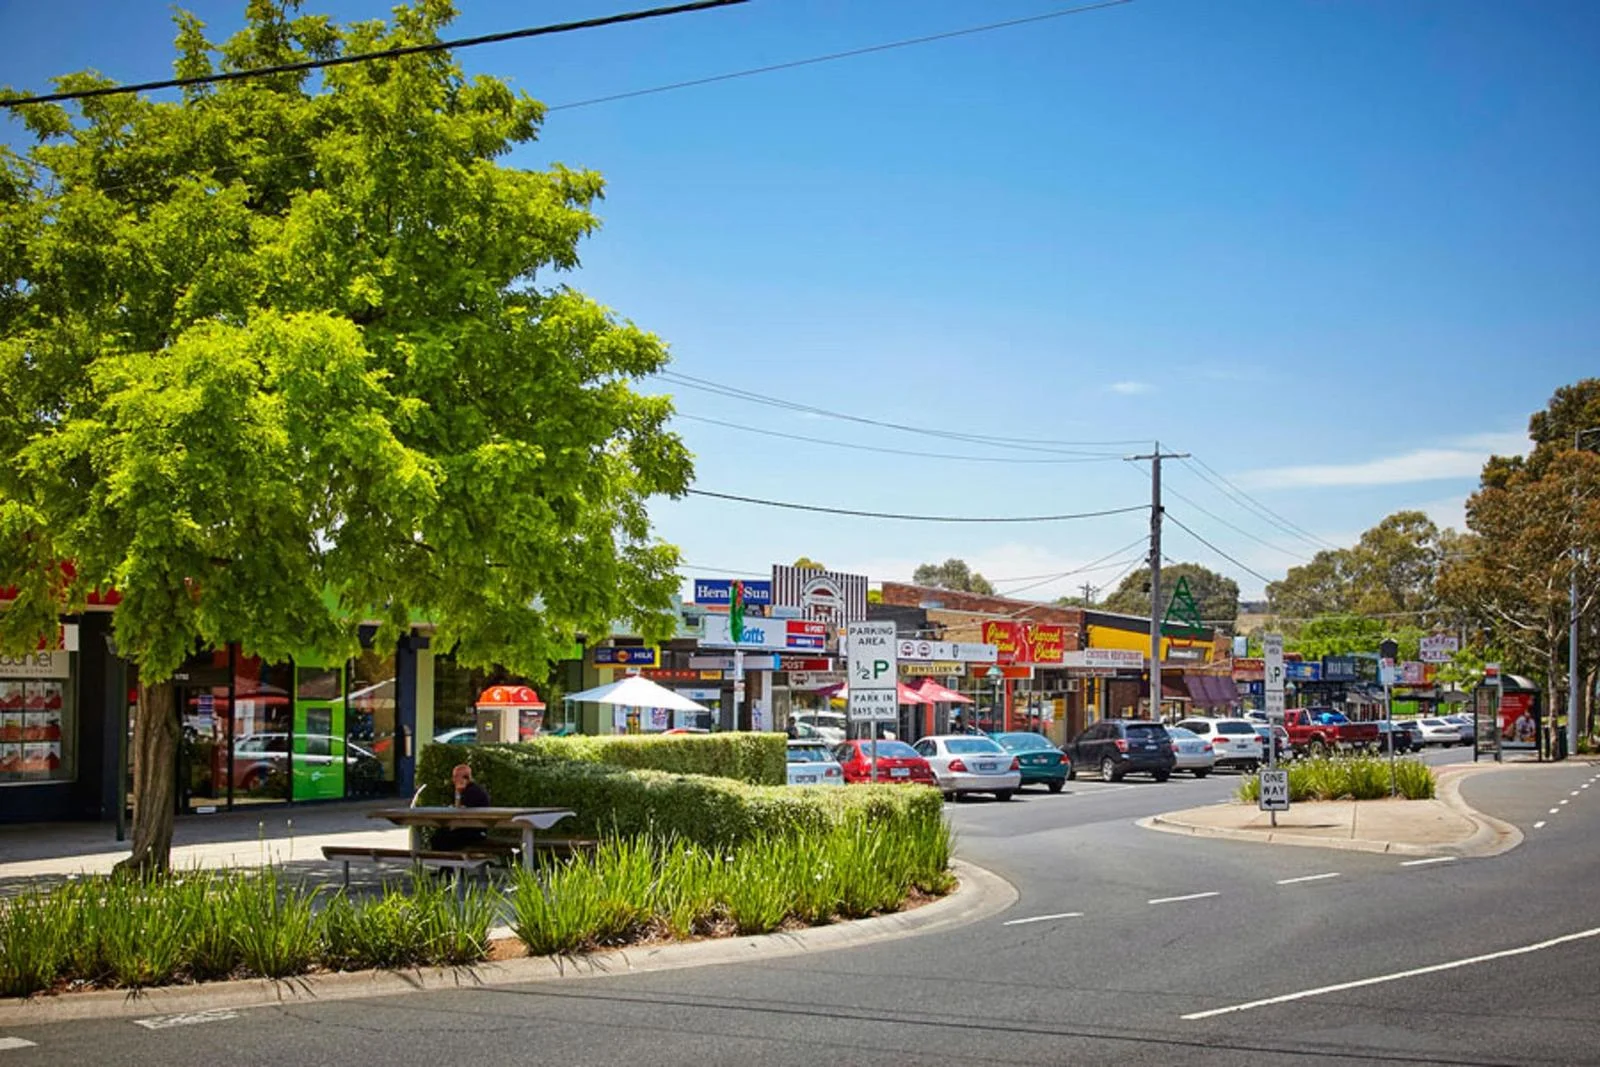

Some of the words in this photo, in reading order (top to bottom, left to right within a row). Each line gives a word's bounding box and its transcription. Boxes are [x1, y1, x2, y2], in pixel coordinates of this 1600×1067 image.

[697, 584, 734, 599] Heral
[743, 587, 769, 599] Sun
[741, 626, 766, 644] atts
[849, 627, 893, 635] PARKING
[858, 638, 886, 646] AREA
[633, 650, 653, 660] MILK
[854, 694, 878, 702] PARK
[883, 694, 893, 702] IN
[875, 706, 894, 715] ONLY
[1263, 773, 1285, 783] ONE
[1263, 785, 1285, 795] WAY
